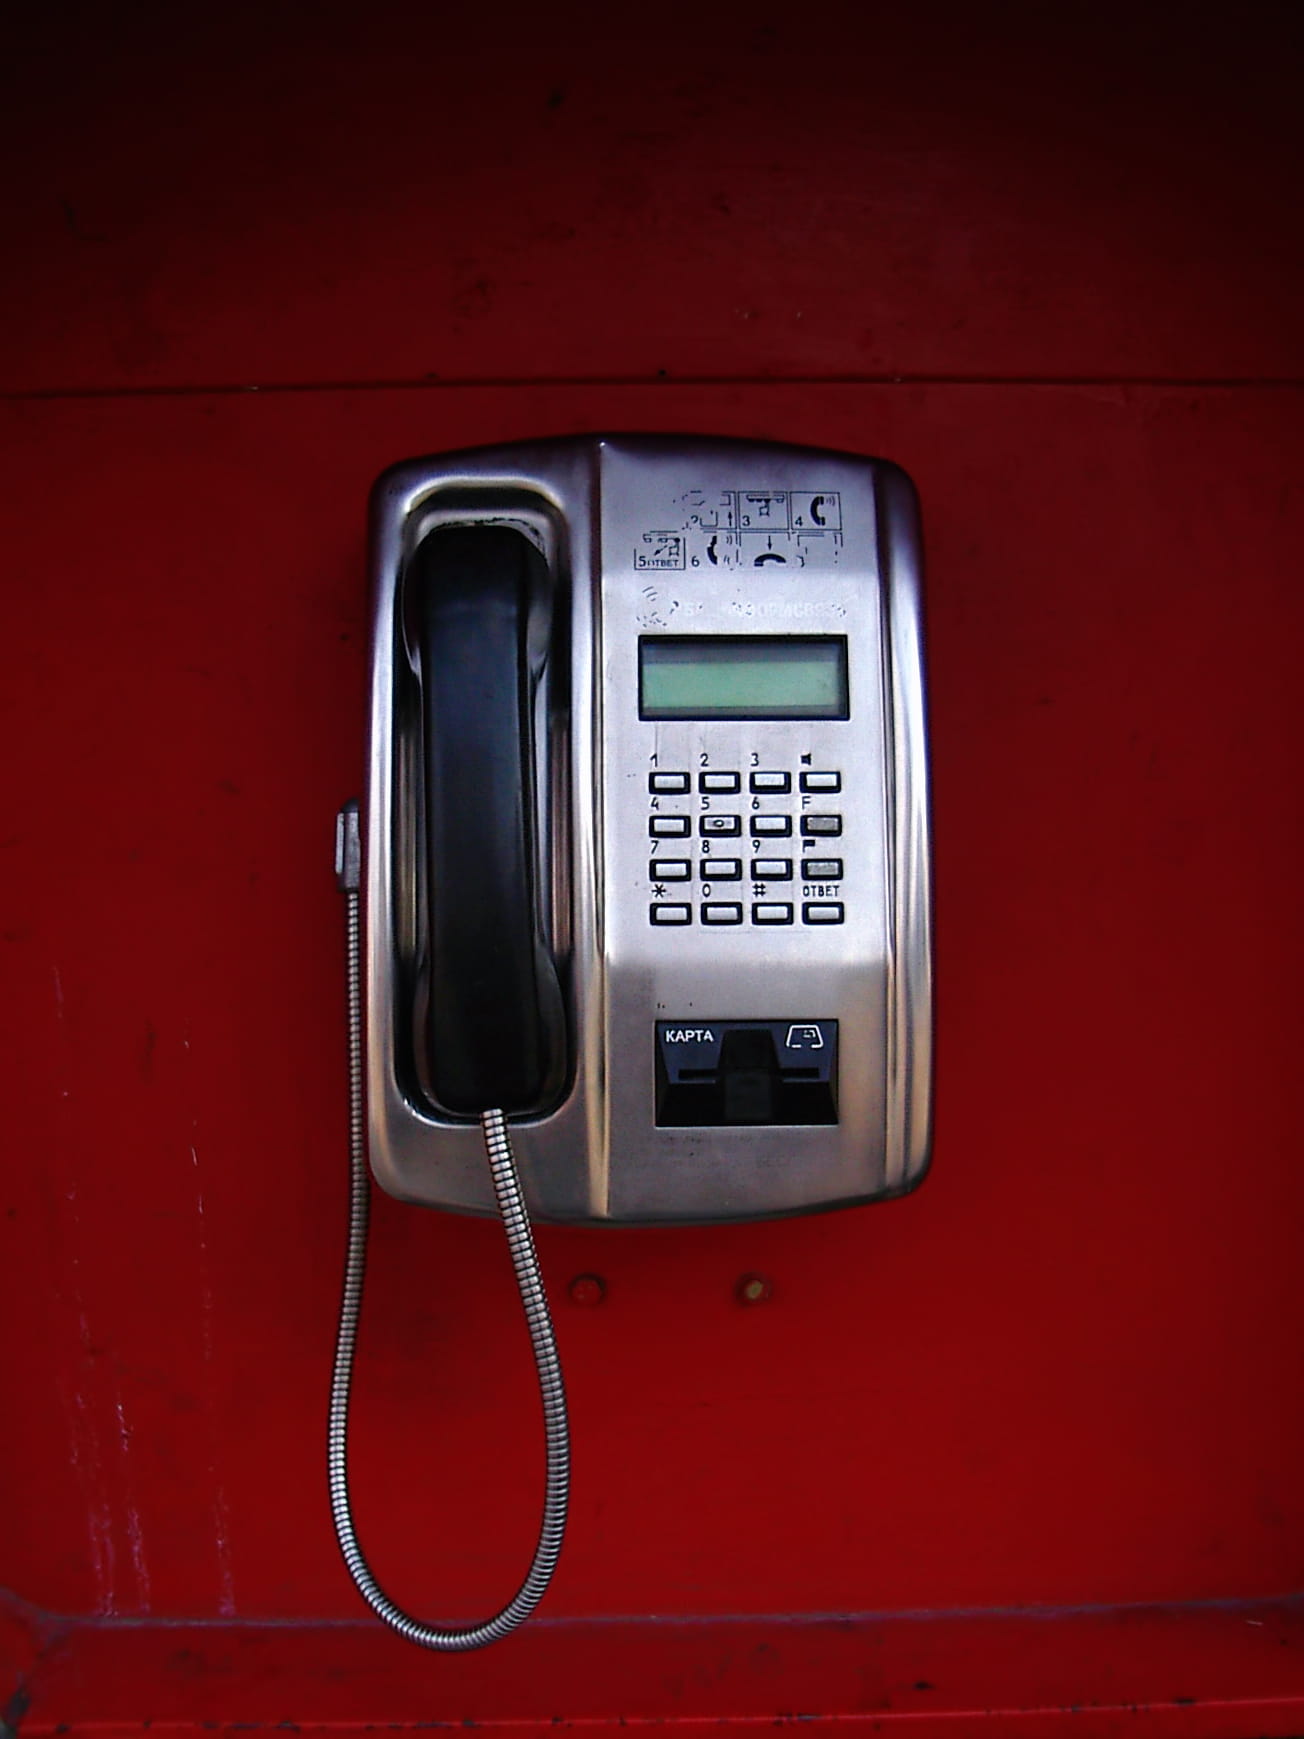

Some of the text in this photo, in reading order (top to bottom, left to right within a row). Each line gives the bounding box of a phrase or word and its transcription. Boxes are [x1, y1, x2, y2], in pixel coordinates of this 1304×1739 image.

[742, 515, 750, 526] 3
[795, 516, 803, 526] 4
[639, 556, 646, 567] 5
[691, 556, 700, 567] 6
[650, 753, 658, 767] 1
[700, 753, 709, 767] 2
[751, 752, 759, 766] 3
[651, 797, 659, 810] 4
[701, 796, 710, 810] 5
[752, 797, 760, 810] 6
[802, 796, 811, 809] F
[651, 840, 659, 854] 7
[702, 840, 710, 853] 8
[753, 840, 760, 853] 9
[702, 884, 711, 898] 0
[753, 884, 766, 897] #
[803, 885, 840, 897] ОТВЕТ
[665, 1029, 714, 1042] КАРТА
